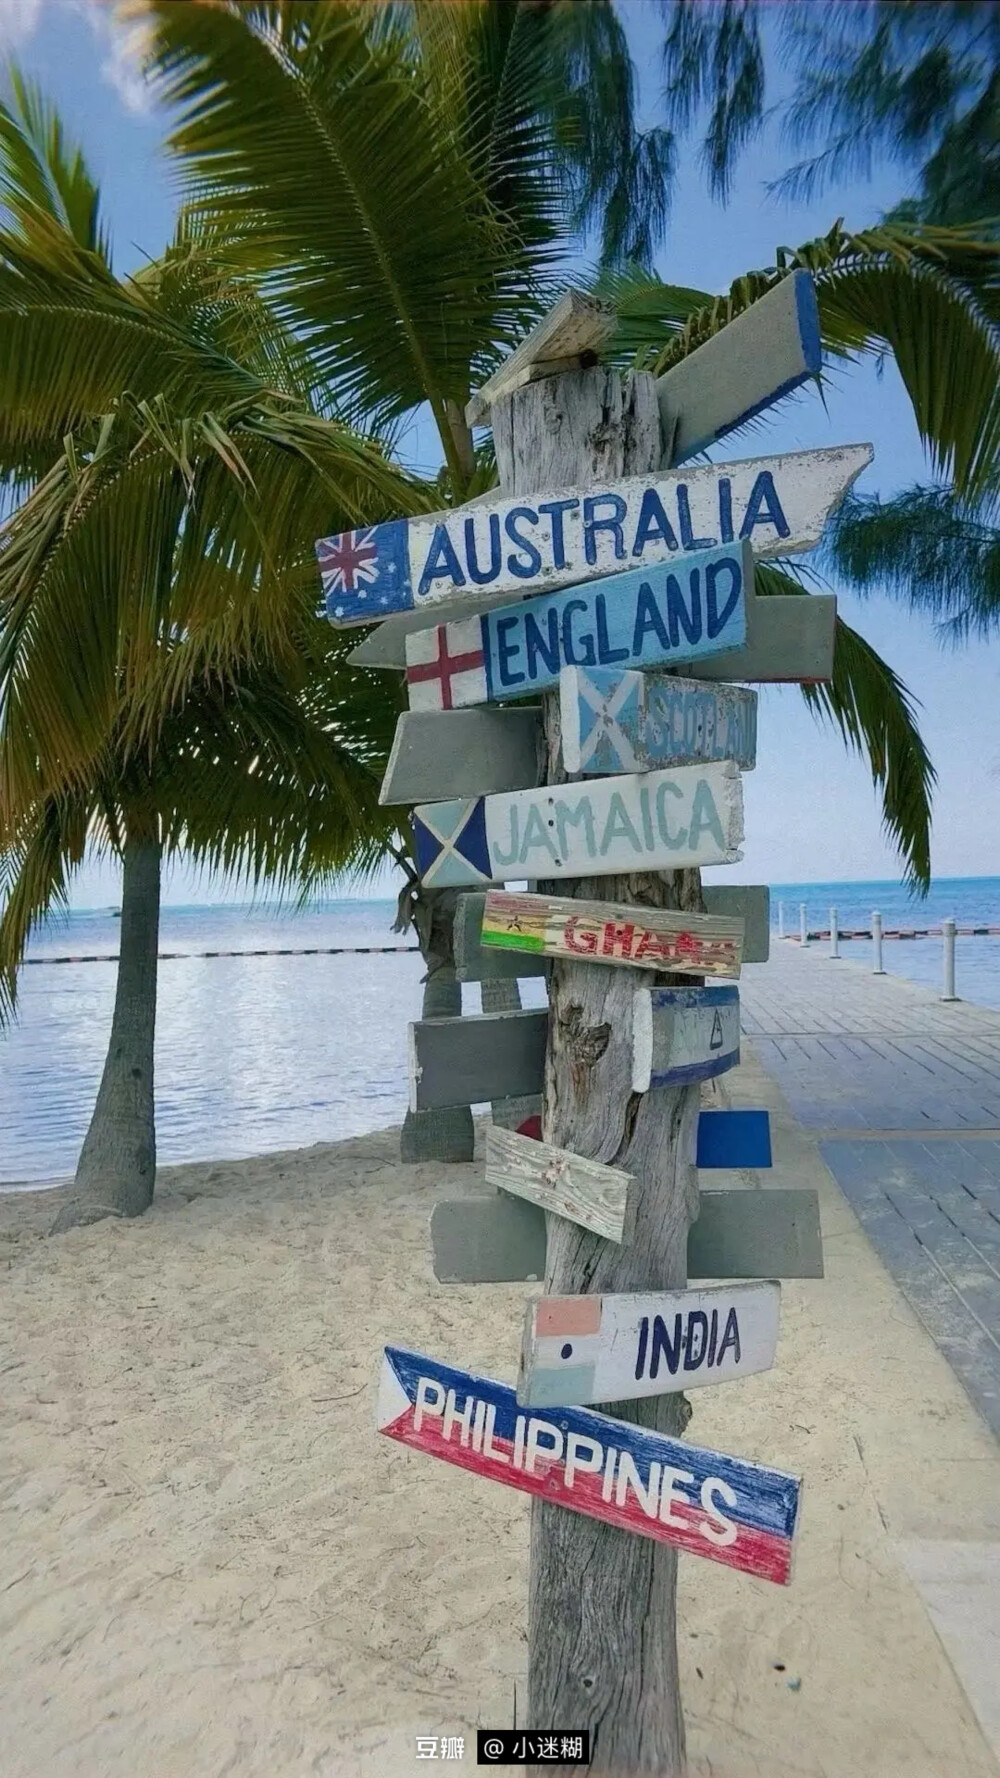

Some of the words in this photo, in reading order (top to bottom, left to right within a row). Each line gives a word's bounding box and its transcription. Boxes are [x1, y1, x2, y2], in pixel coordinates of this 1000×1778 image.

[418, 470, 791, 595] AUSTRALIA
[498, 556, 742, 687] ENGLAND
[493, 779, 726, 865] JAMAICA
[635, 1306, 741, 1380] INDIA
[413, 1377, 738, 1547] PHILIPPINES
